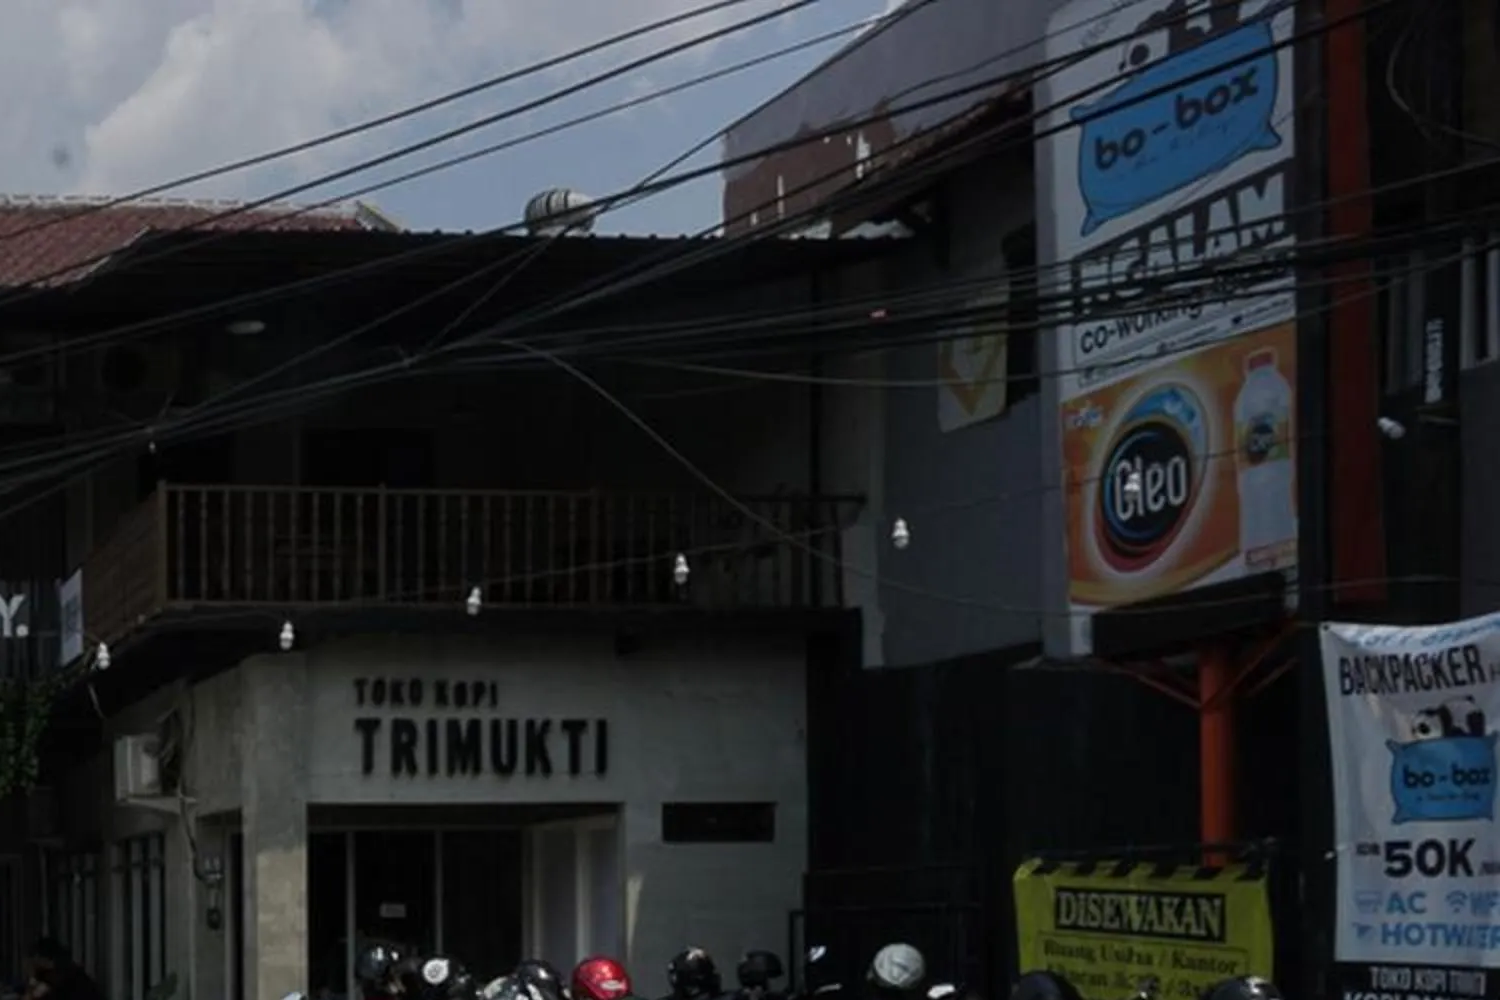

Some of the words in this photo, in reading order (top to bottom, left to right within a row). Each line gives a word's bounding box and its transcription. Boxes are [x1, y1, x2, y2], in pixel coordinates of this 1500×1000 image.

[1094, 66, 1259, 171] bo-box
[1113, 453, 1189, 522] Cleo
[353, 677, 423, 707] TOKO
[434, 680, 498, 708] KOPI
[355, 717, 608, 777] TRIMUKTI
[1384, 838, 1476, 878] 50K
[1057, 890, 1224, 939] DISEWAKAN
[1385, 890, 1428, 915] AC
